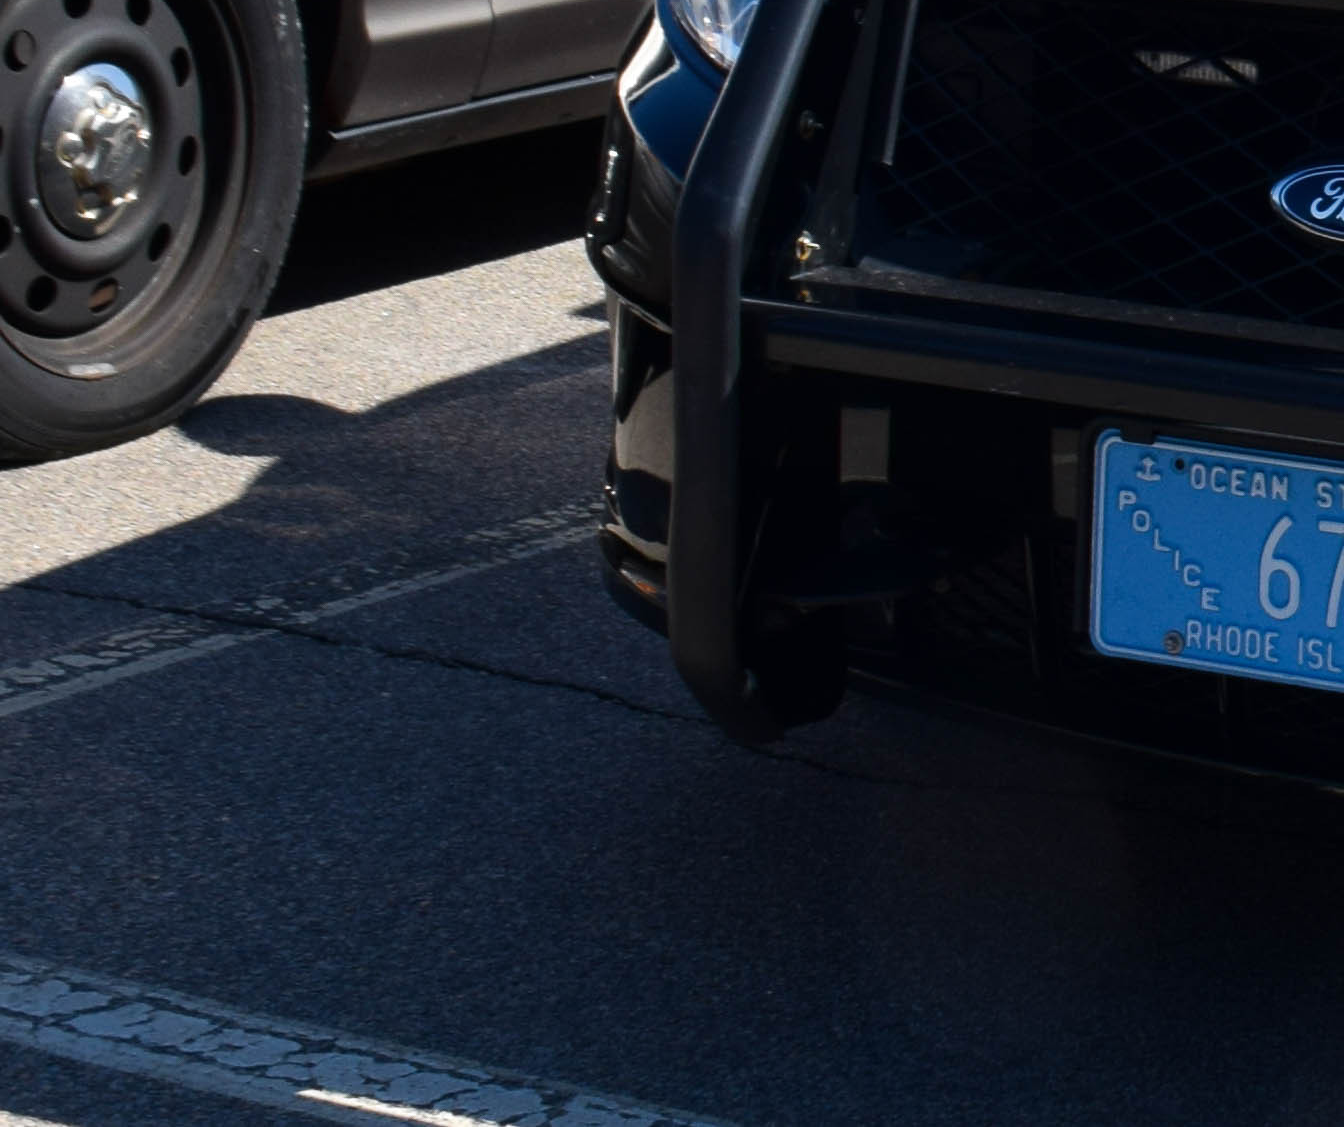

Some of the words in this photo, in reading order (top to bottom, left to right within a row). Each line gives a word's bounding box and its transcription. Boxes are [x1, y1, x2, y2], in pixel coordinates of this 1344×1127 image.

[1189, 462, 1289, 502] OCEAN
[1118, 490, 1222, 612] POLICE
[1184, 619, 1280, 664] RHODE
